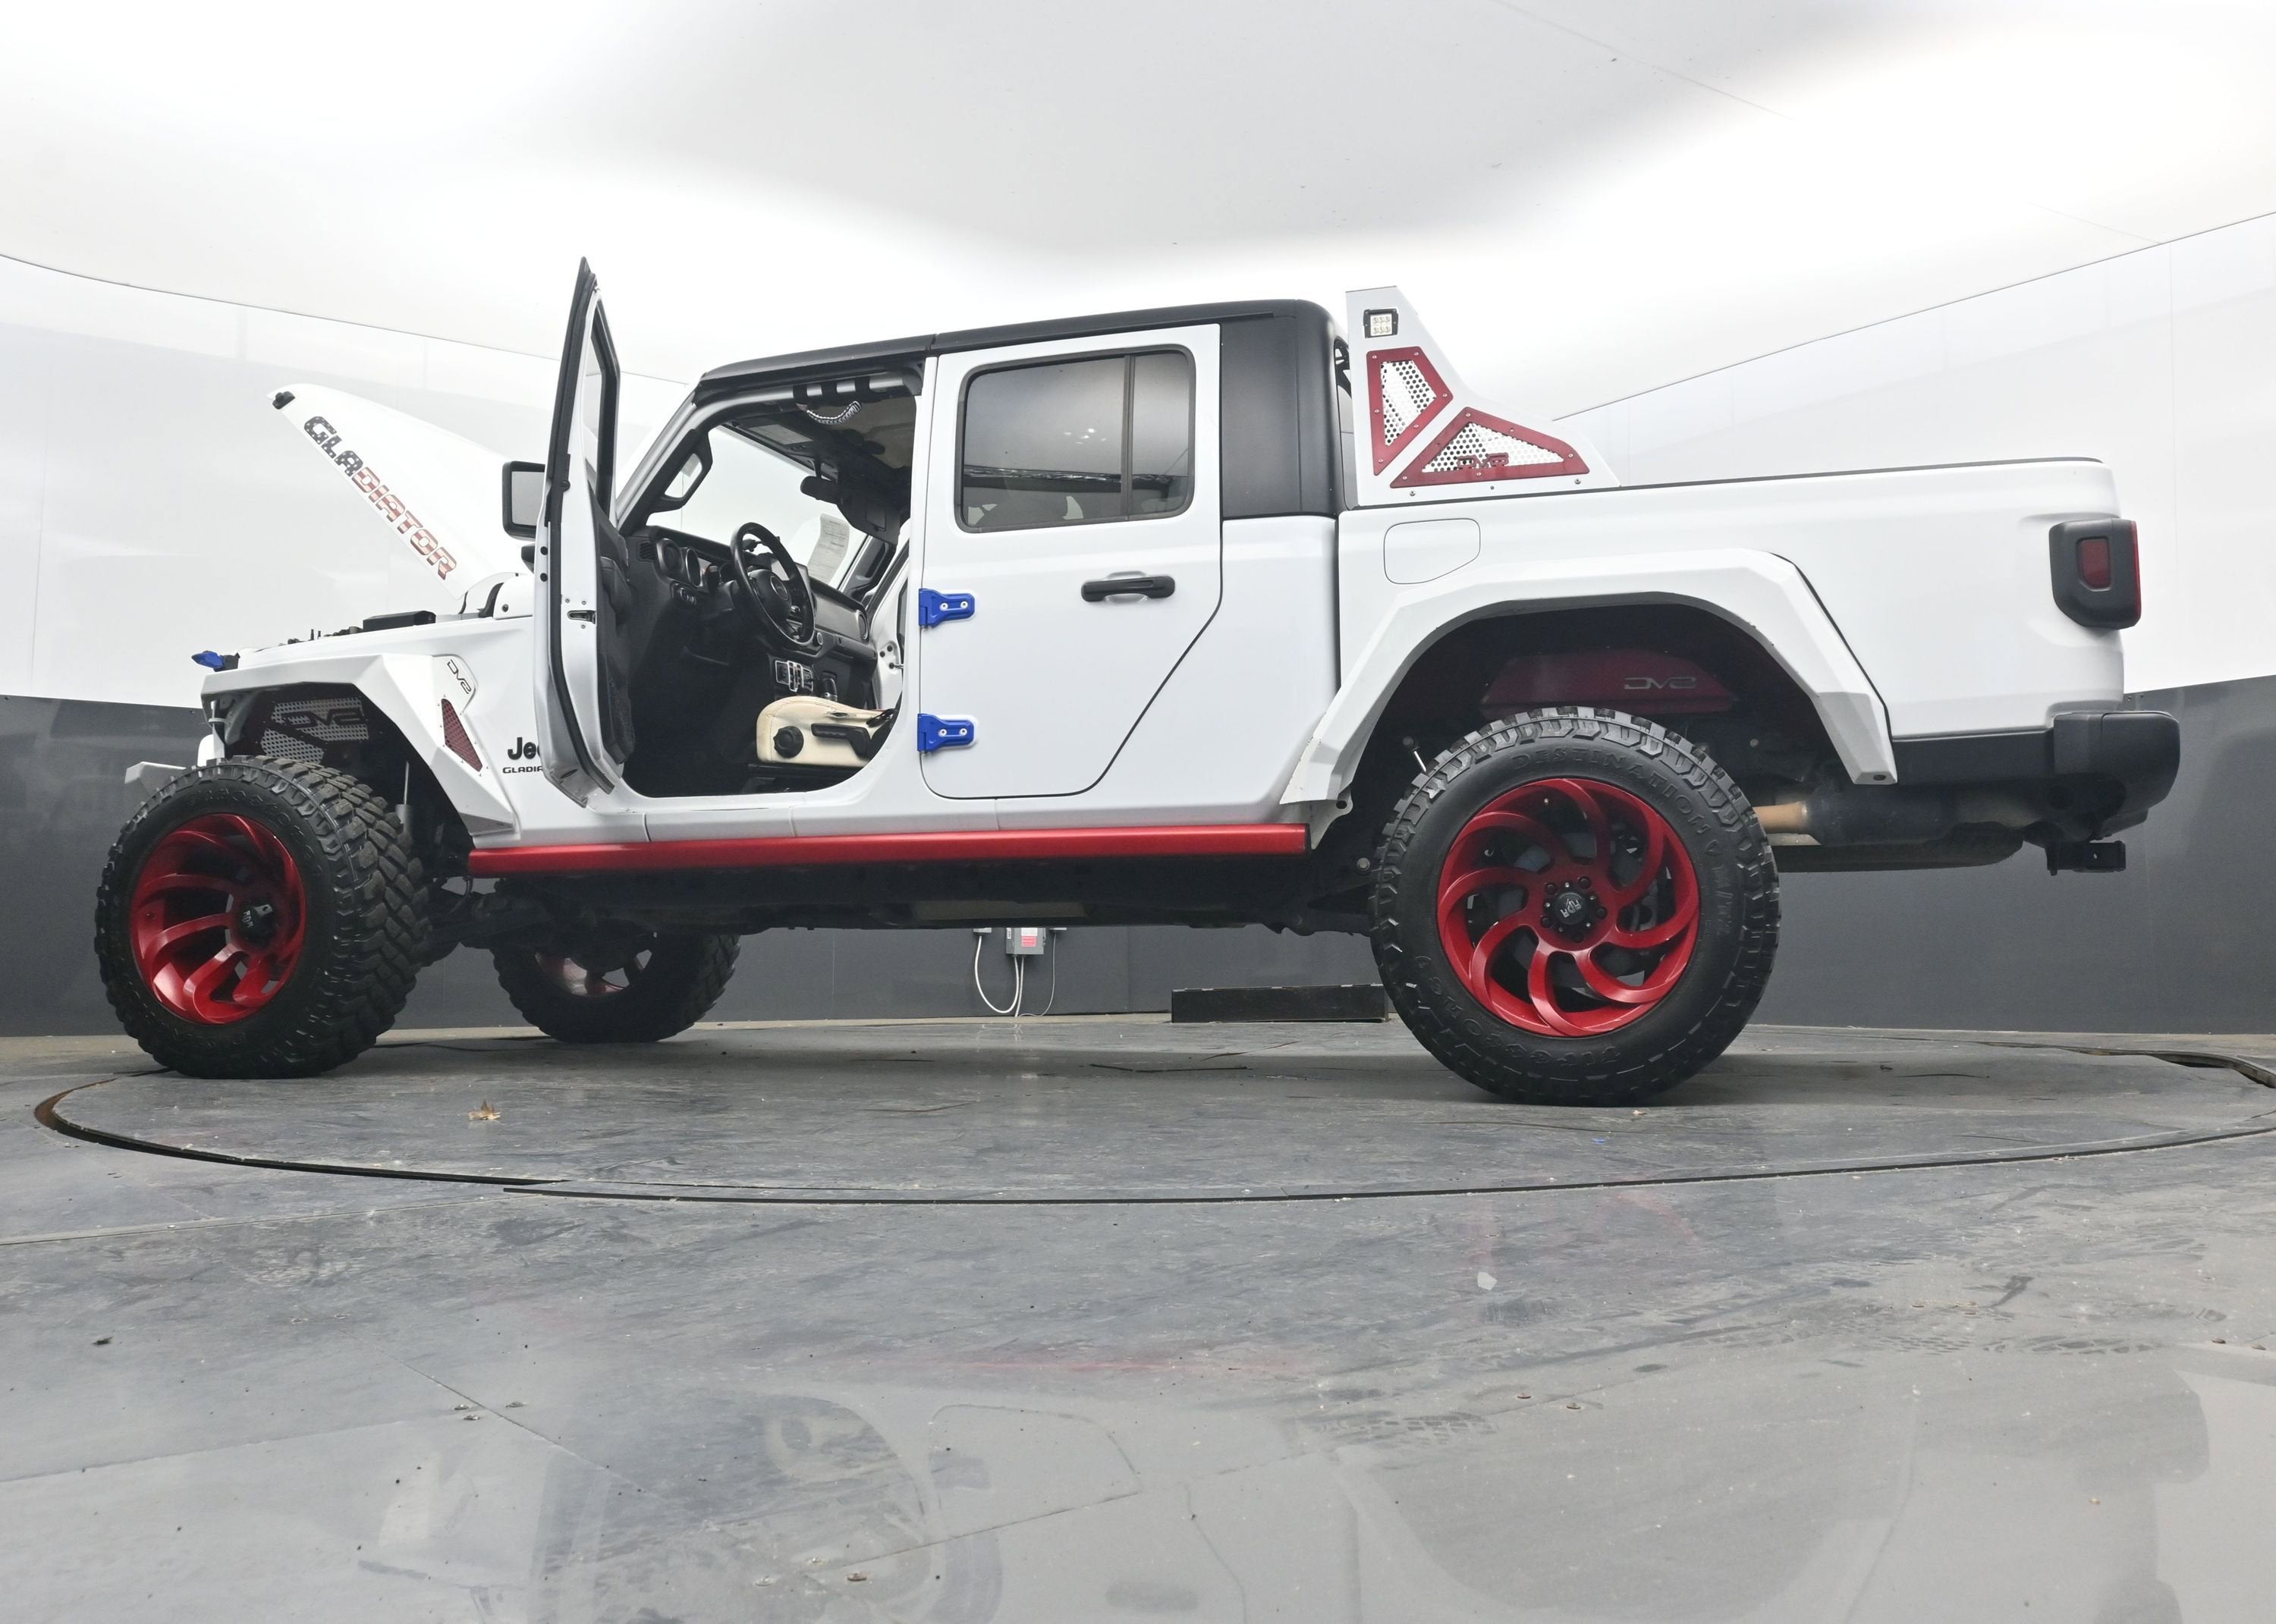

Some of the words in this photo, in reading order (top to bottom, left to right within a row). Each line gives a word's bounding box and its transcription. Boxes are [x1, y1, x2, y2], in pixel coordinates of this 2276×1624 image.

[303, 416, 457, 580] GLADIATOR
[508, 737, 540, 760] Je
[1511, 747, 1712, 834] DESTINATION
